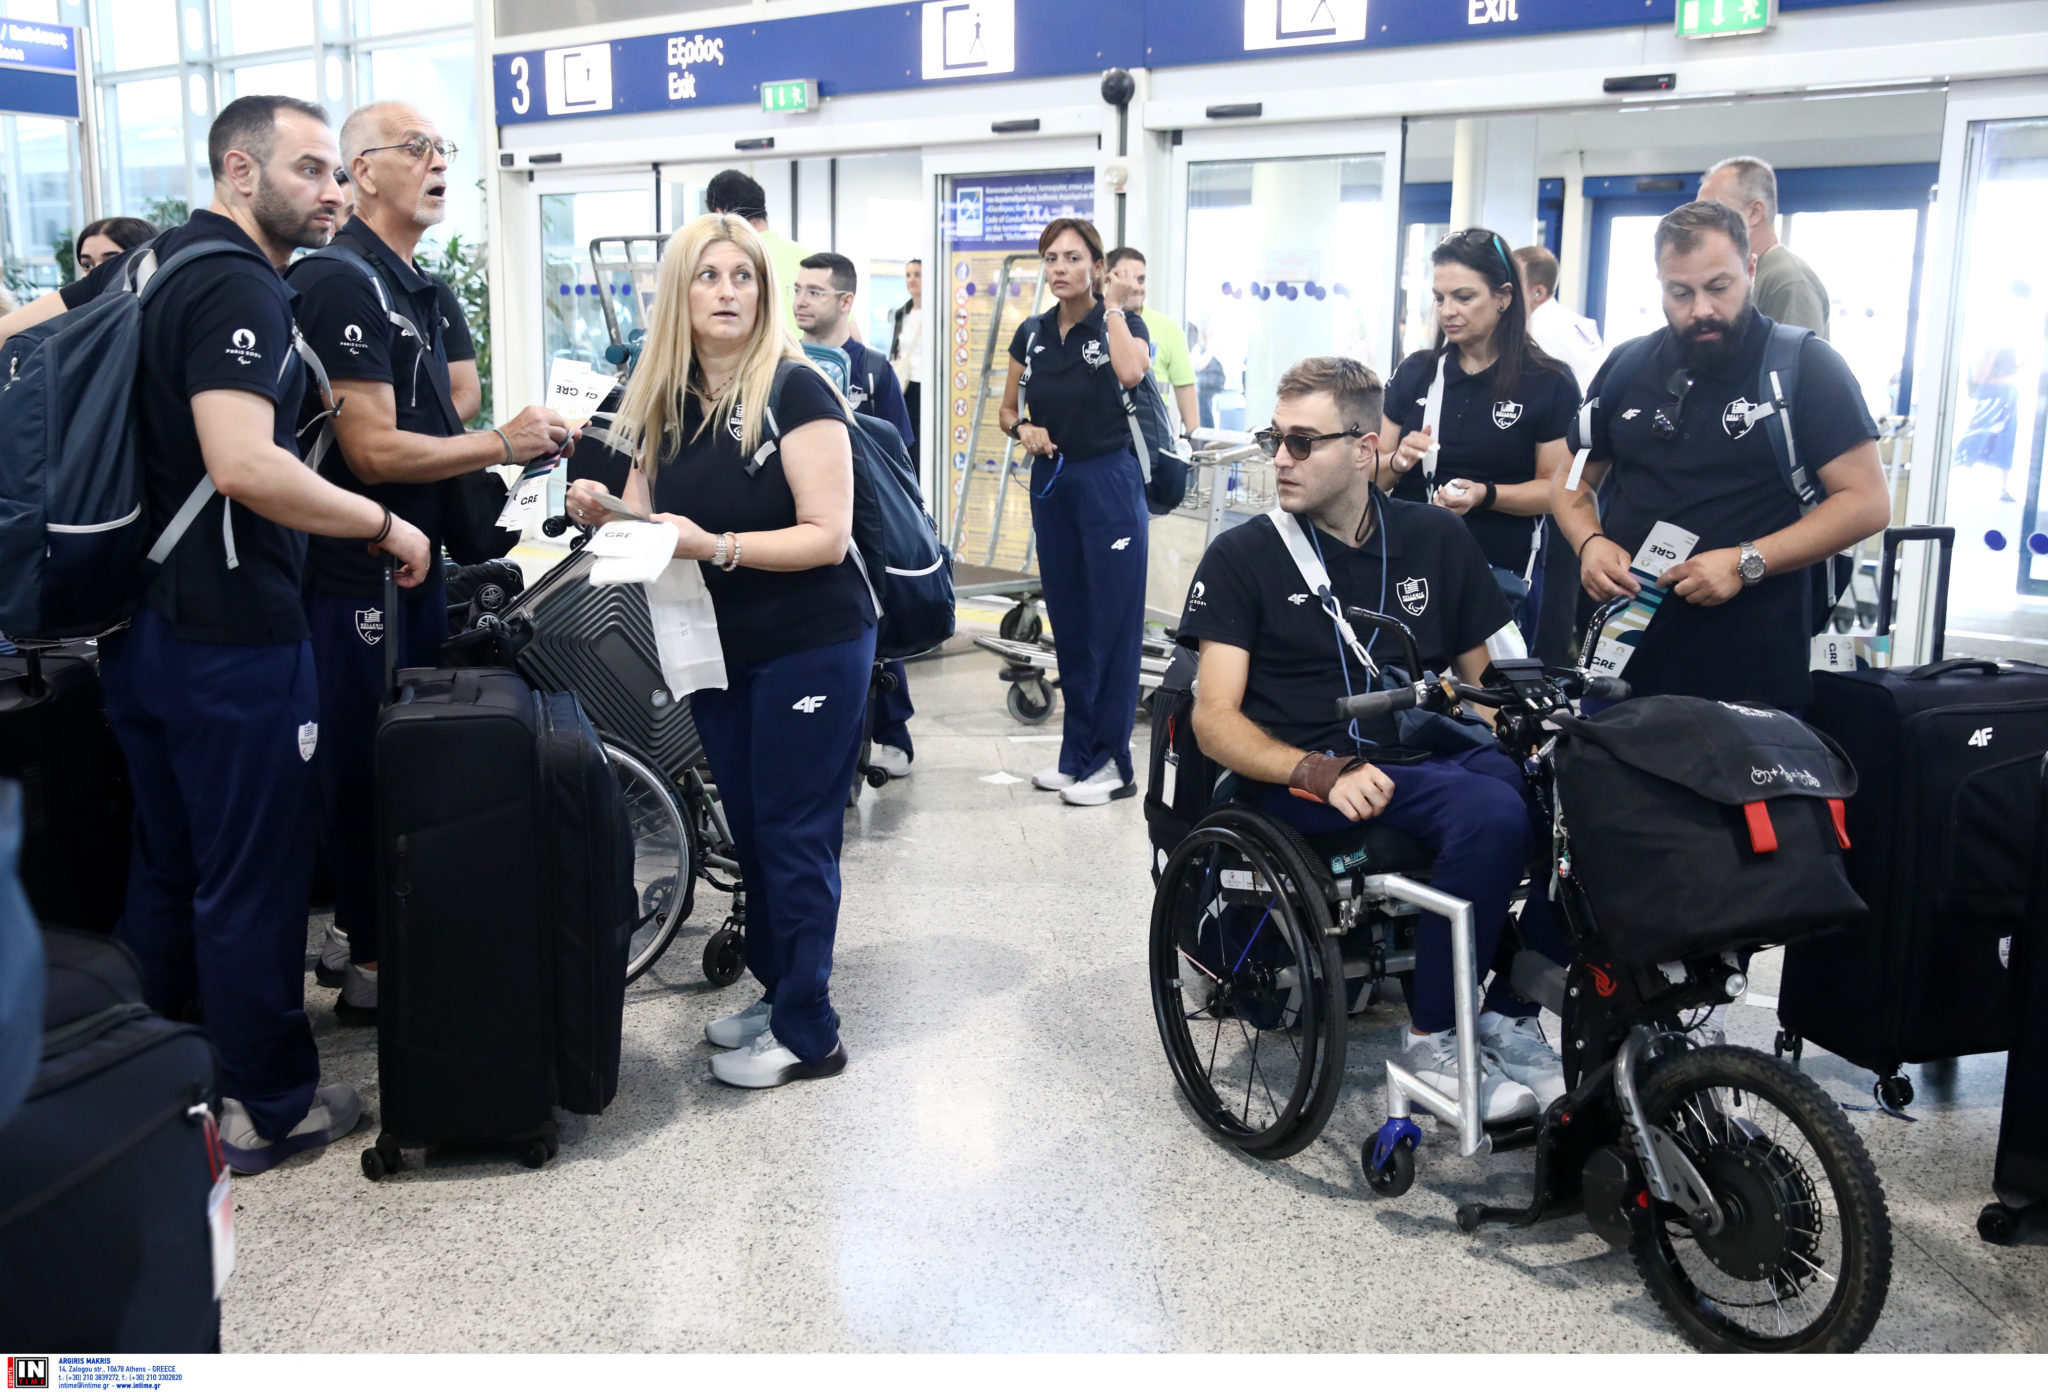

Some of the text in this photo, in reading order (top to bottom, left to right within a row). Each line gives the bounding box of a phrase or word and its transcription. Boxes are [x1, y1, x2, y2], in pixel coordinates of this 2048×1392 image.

[510, 56, 531, 115] 3
[667, 71, 697, 100] Exit
[555, 384, 579, 397] GRE
[1621, 408, 1642, 420] 4F
[520, 494, 538, 506] GRE
[605, 531, 632, 539] GRE
[1110, 536, 1131, 551] 4F
[1649, 544, 1677, 560] GRE
[1287, 593, 1309, 606] 4F
[1828, 642, 1838, 666] GRE
[1592, 656, 1617, 671] GRE
[792, 695, 827, 713] 4F
[1968, 727, 1993, 747] 4F
